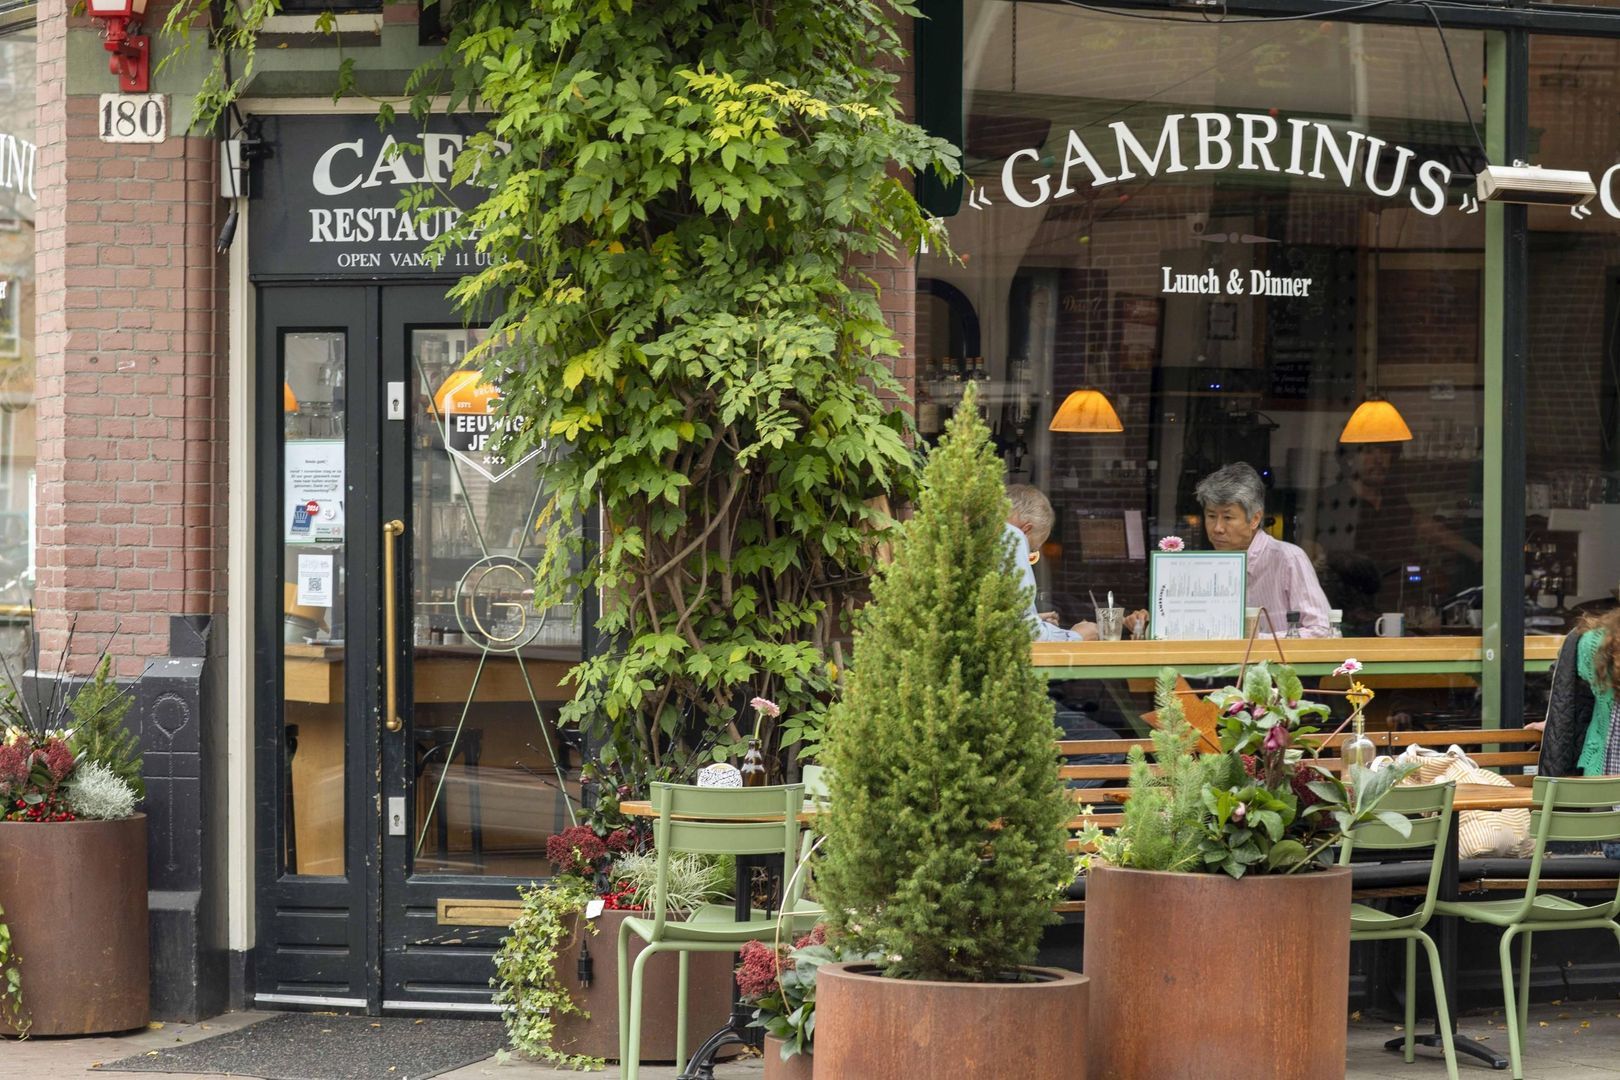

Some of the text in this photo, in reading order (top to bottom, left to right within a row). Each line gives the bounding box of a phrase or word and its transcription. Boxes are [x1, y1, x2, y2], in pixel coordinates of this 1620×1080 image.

[102, 100, 162, 136] 180
[337, 253, 381, 267] OPEN
[455, 253, 469, 266] 11
[1162, 266, 1312, 297] Lunch & Dinner
